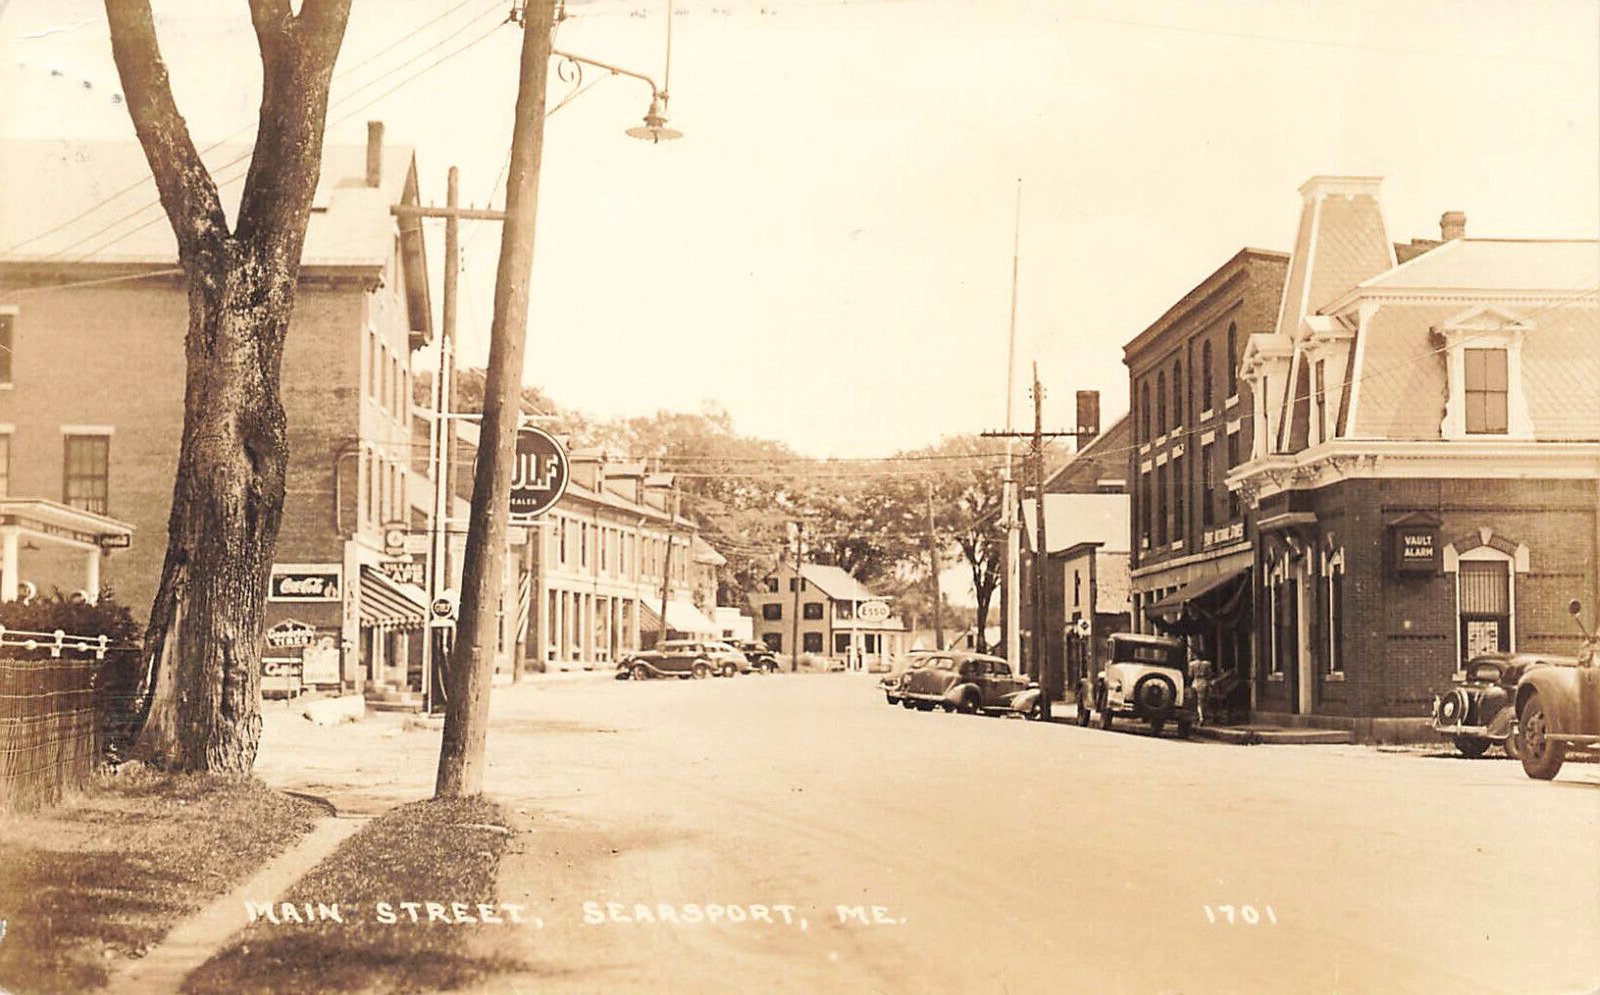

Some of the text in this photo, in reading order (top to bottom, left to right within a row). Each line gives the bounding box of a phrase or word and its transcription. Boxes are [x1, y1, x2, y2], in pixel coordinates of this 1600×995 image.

[510, 453, 559, 490] ULF
[1404, 535, 1432, 545] VAULT
[1404, 547, 1433, 557] ALARM
